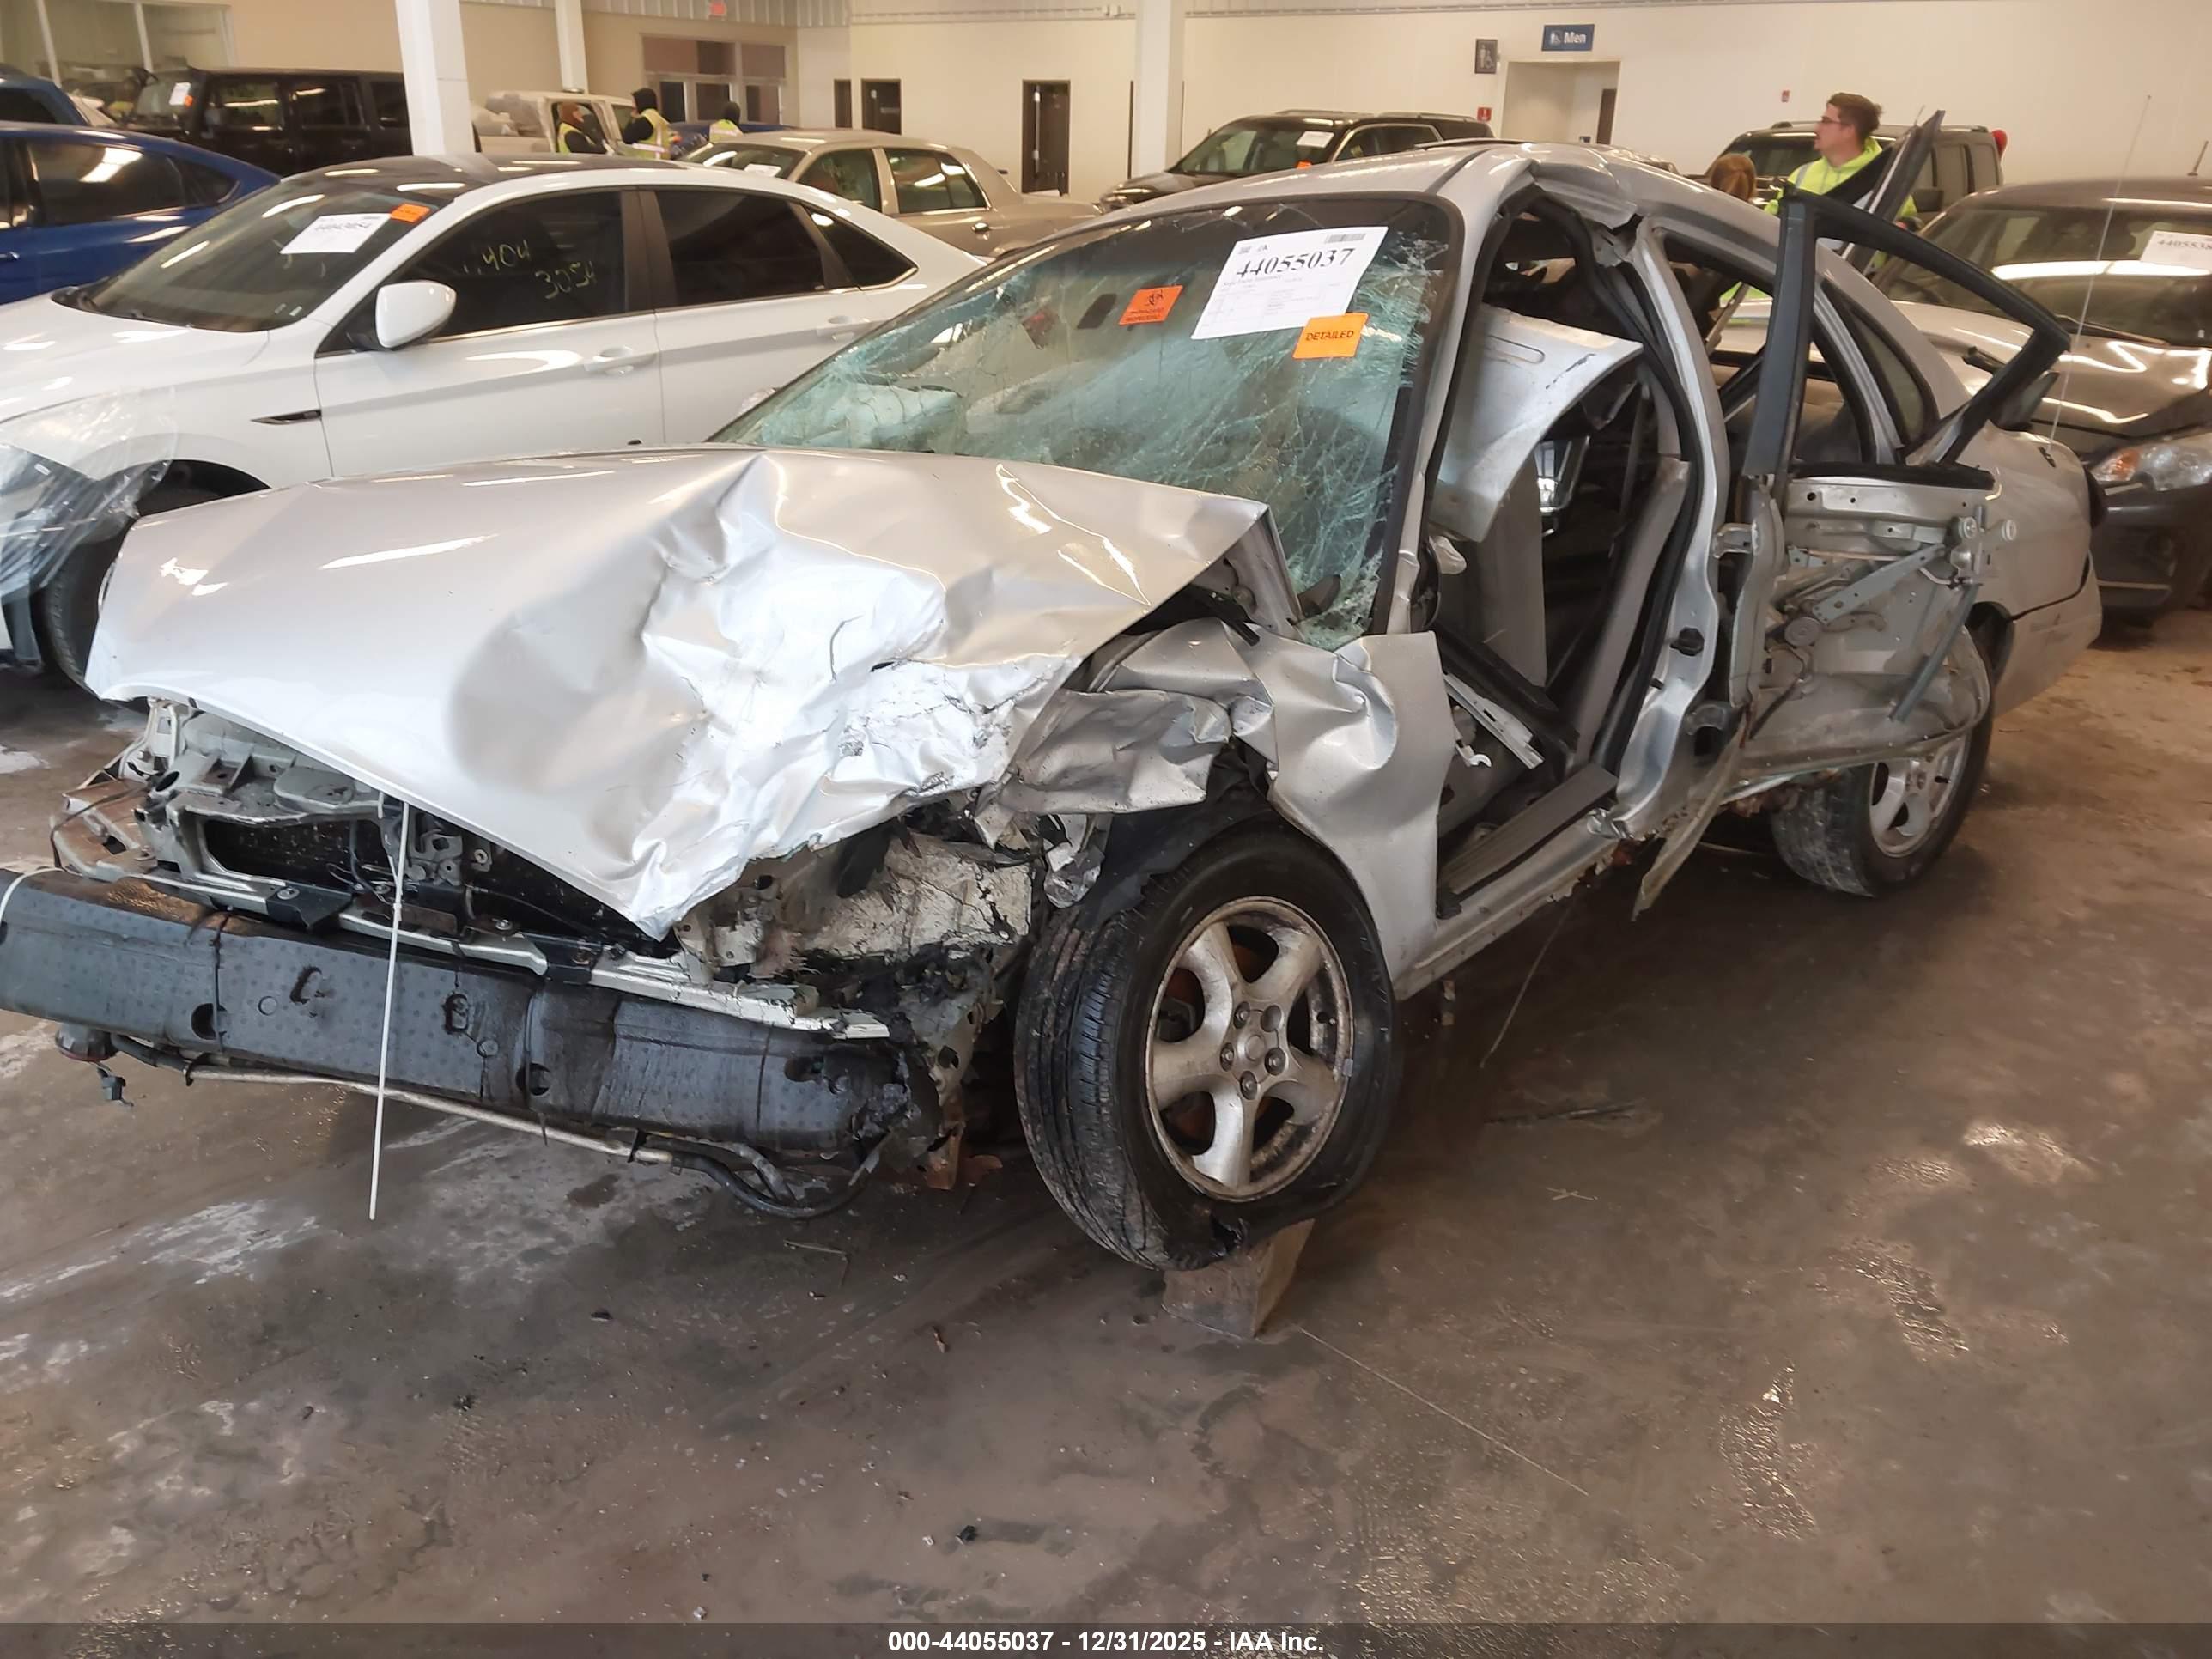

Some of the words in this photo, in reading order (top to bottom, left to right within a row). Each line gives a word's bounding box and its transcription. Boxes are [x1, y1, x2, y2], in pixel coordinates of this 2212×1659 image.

[1564, 31, 1587, 44] Men
[1236, 247, 1356, 277] 44055037
[1306, 329, 1354, 342] DETAILED
